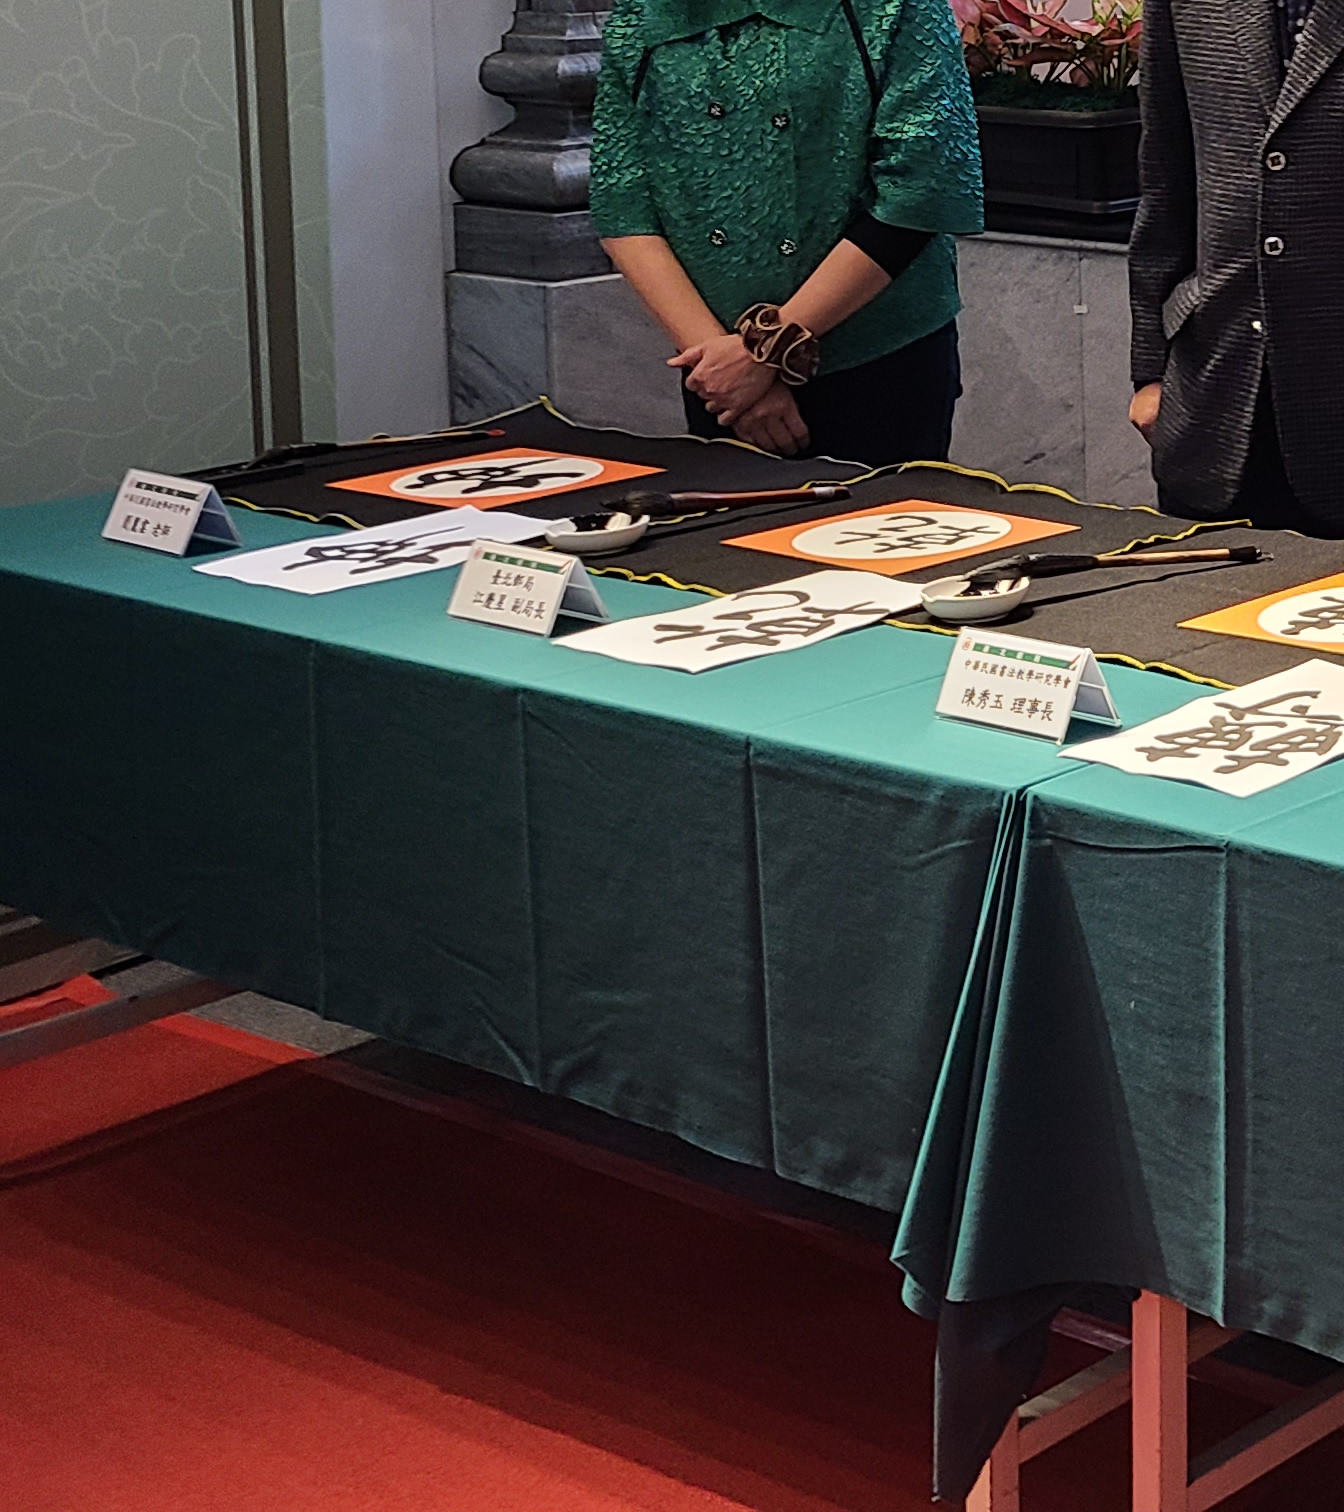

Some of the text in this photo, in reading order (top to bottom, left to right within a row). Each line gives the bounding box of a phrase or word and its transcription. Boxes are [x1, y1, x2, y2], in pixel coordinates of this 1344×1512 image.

[490, 569, 535, 592] 臺北郵局
[961, 686, 1055, 722] 陳秀玉 理事長
